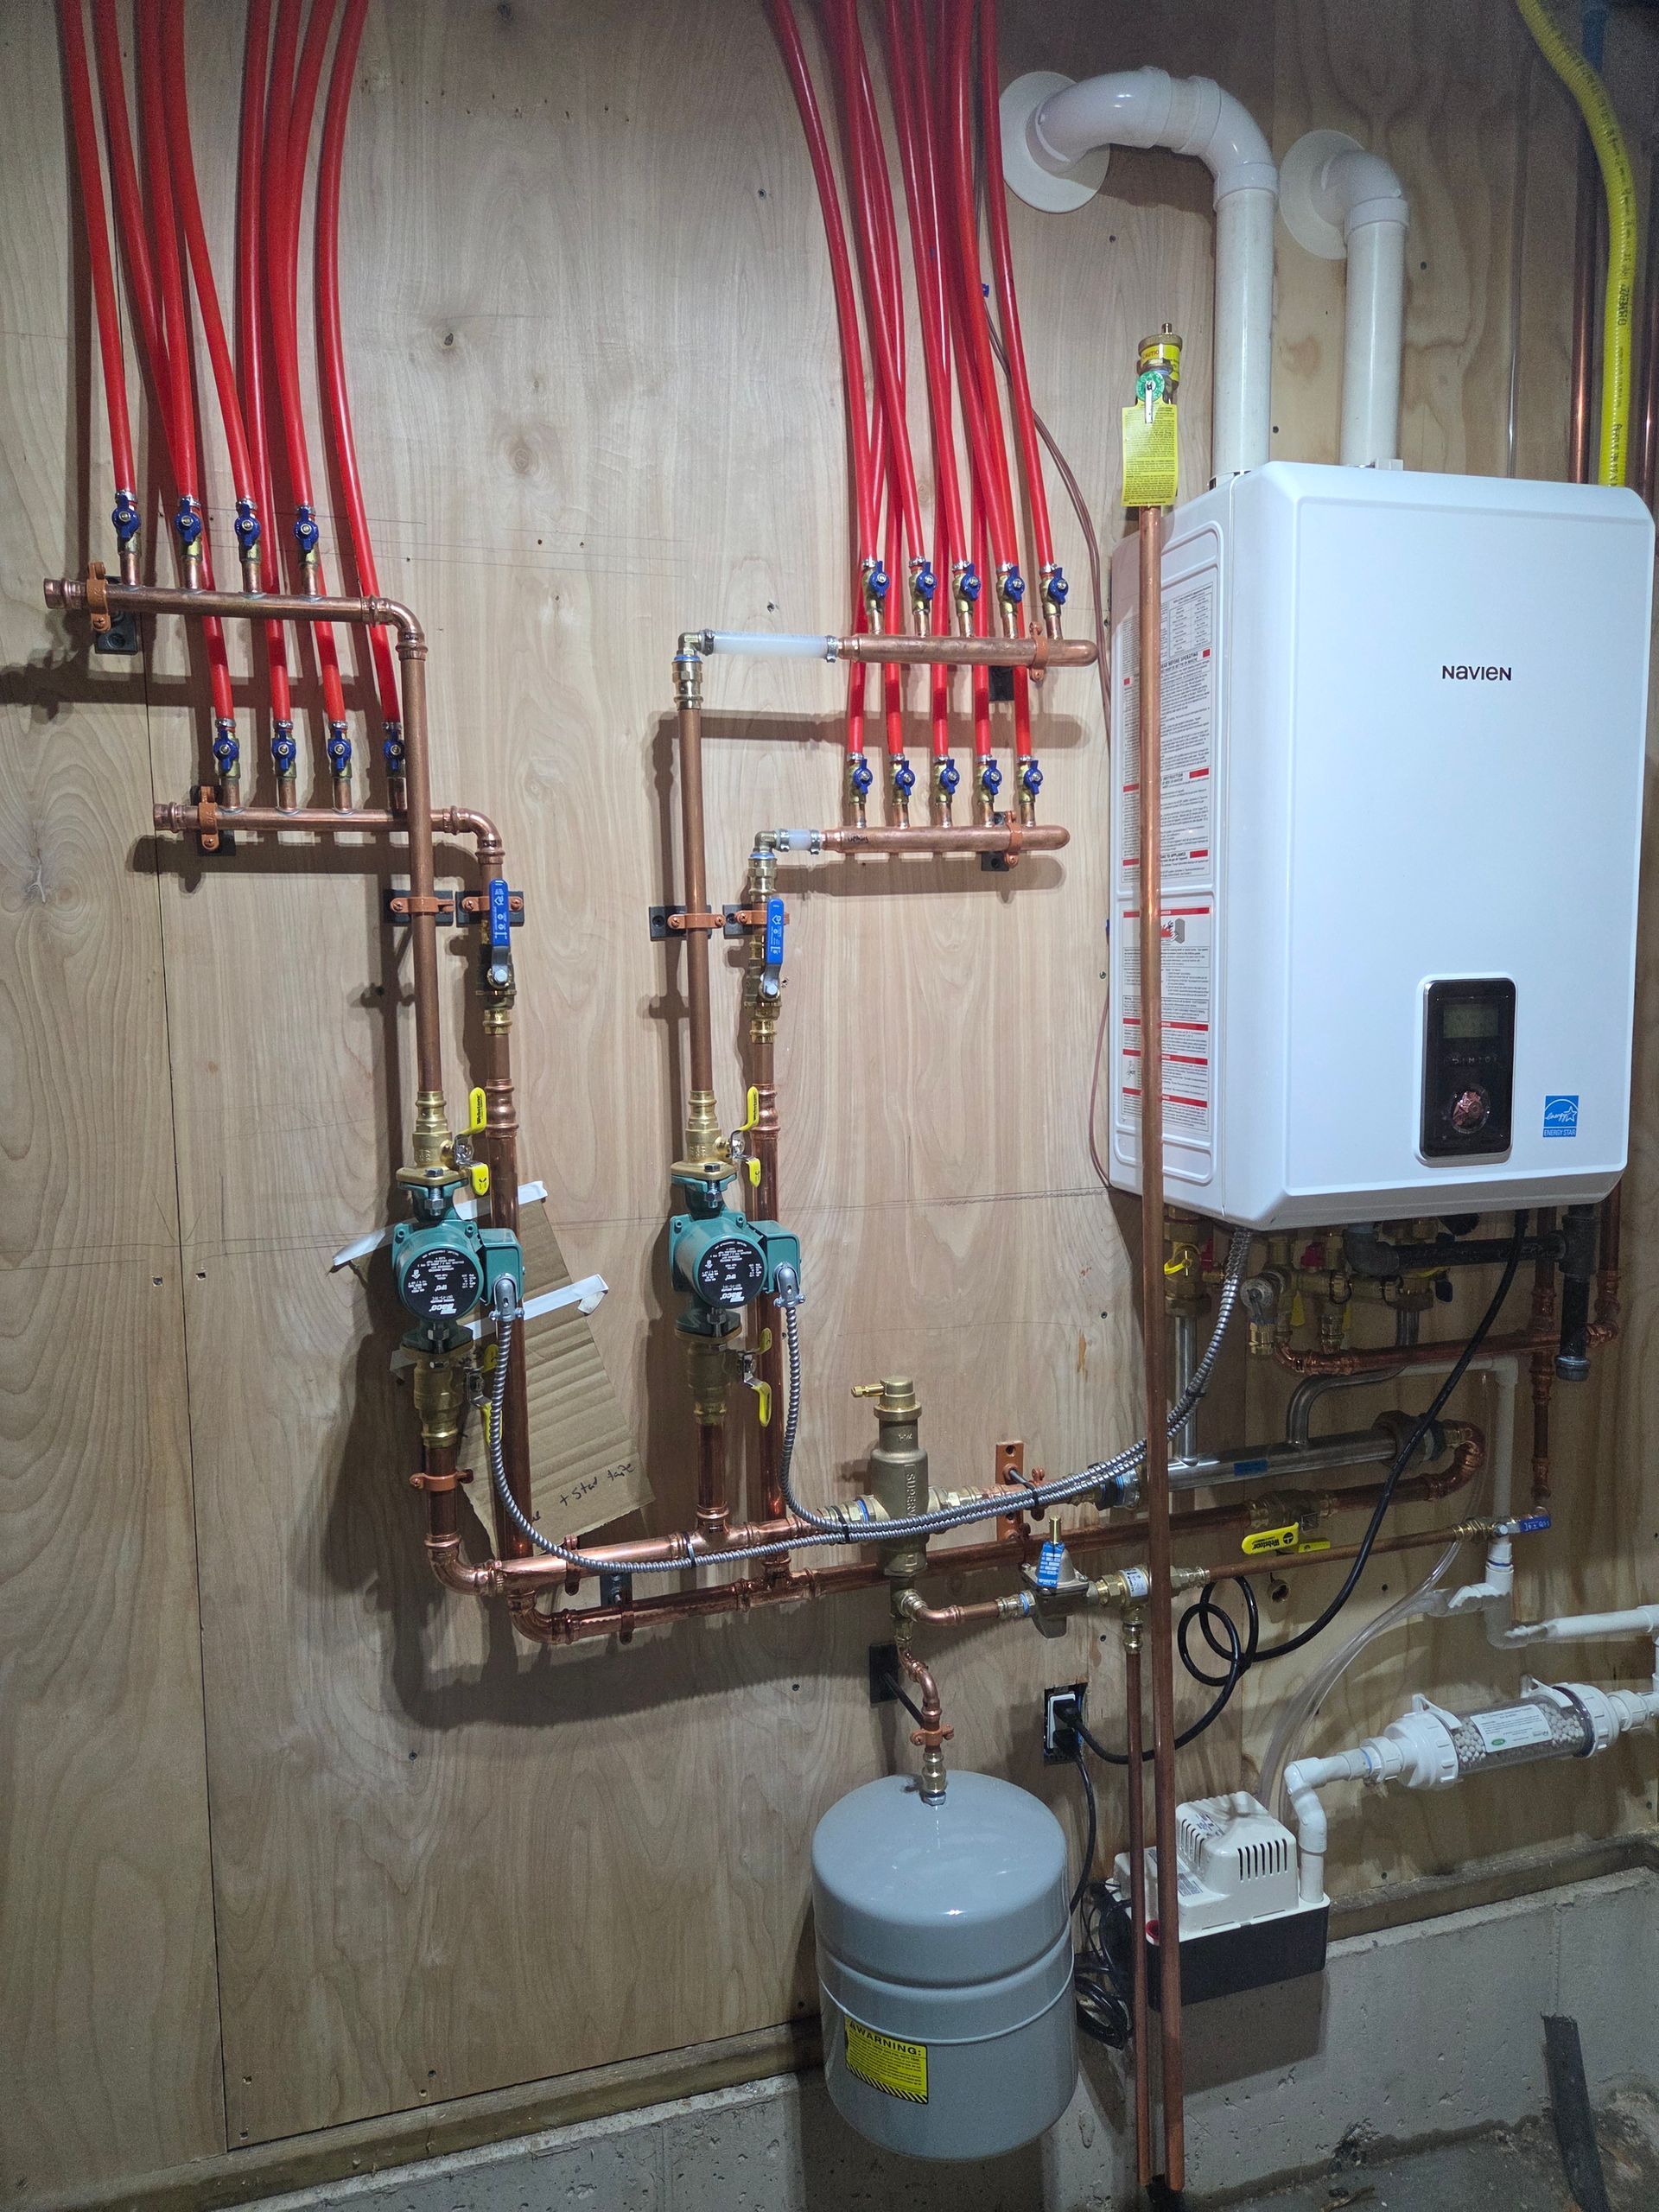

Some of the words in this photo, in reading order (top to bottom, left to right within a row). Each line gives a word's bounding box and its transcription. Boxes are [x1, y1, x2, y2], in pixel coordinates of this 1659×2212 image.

[720, 1292, 745, 1303] Taco
[429, 1303, 457, 1315] Taco
[857, 2027, 922, 2056] WARNING:
